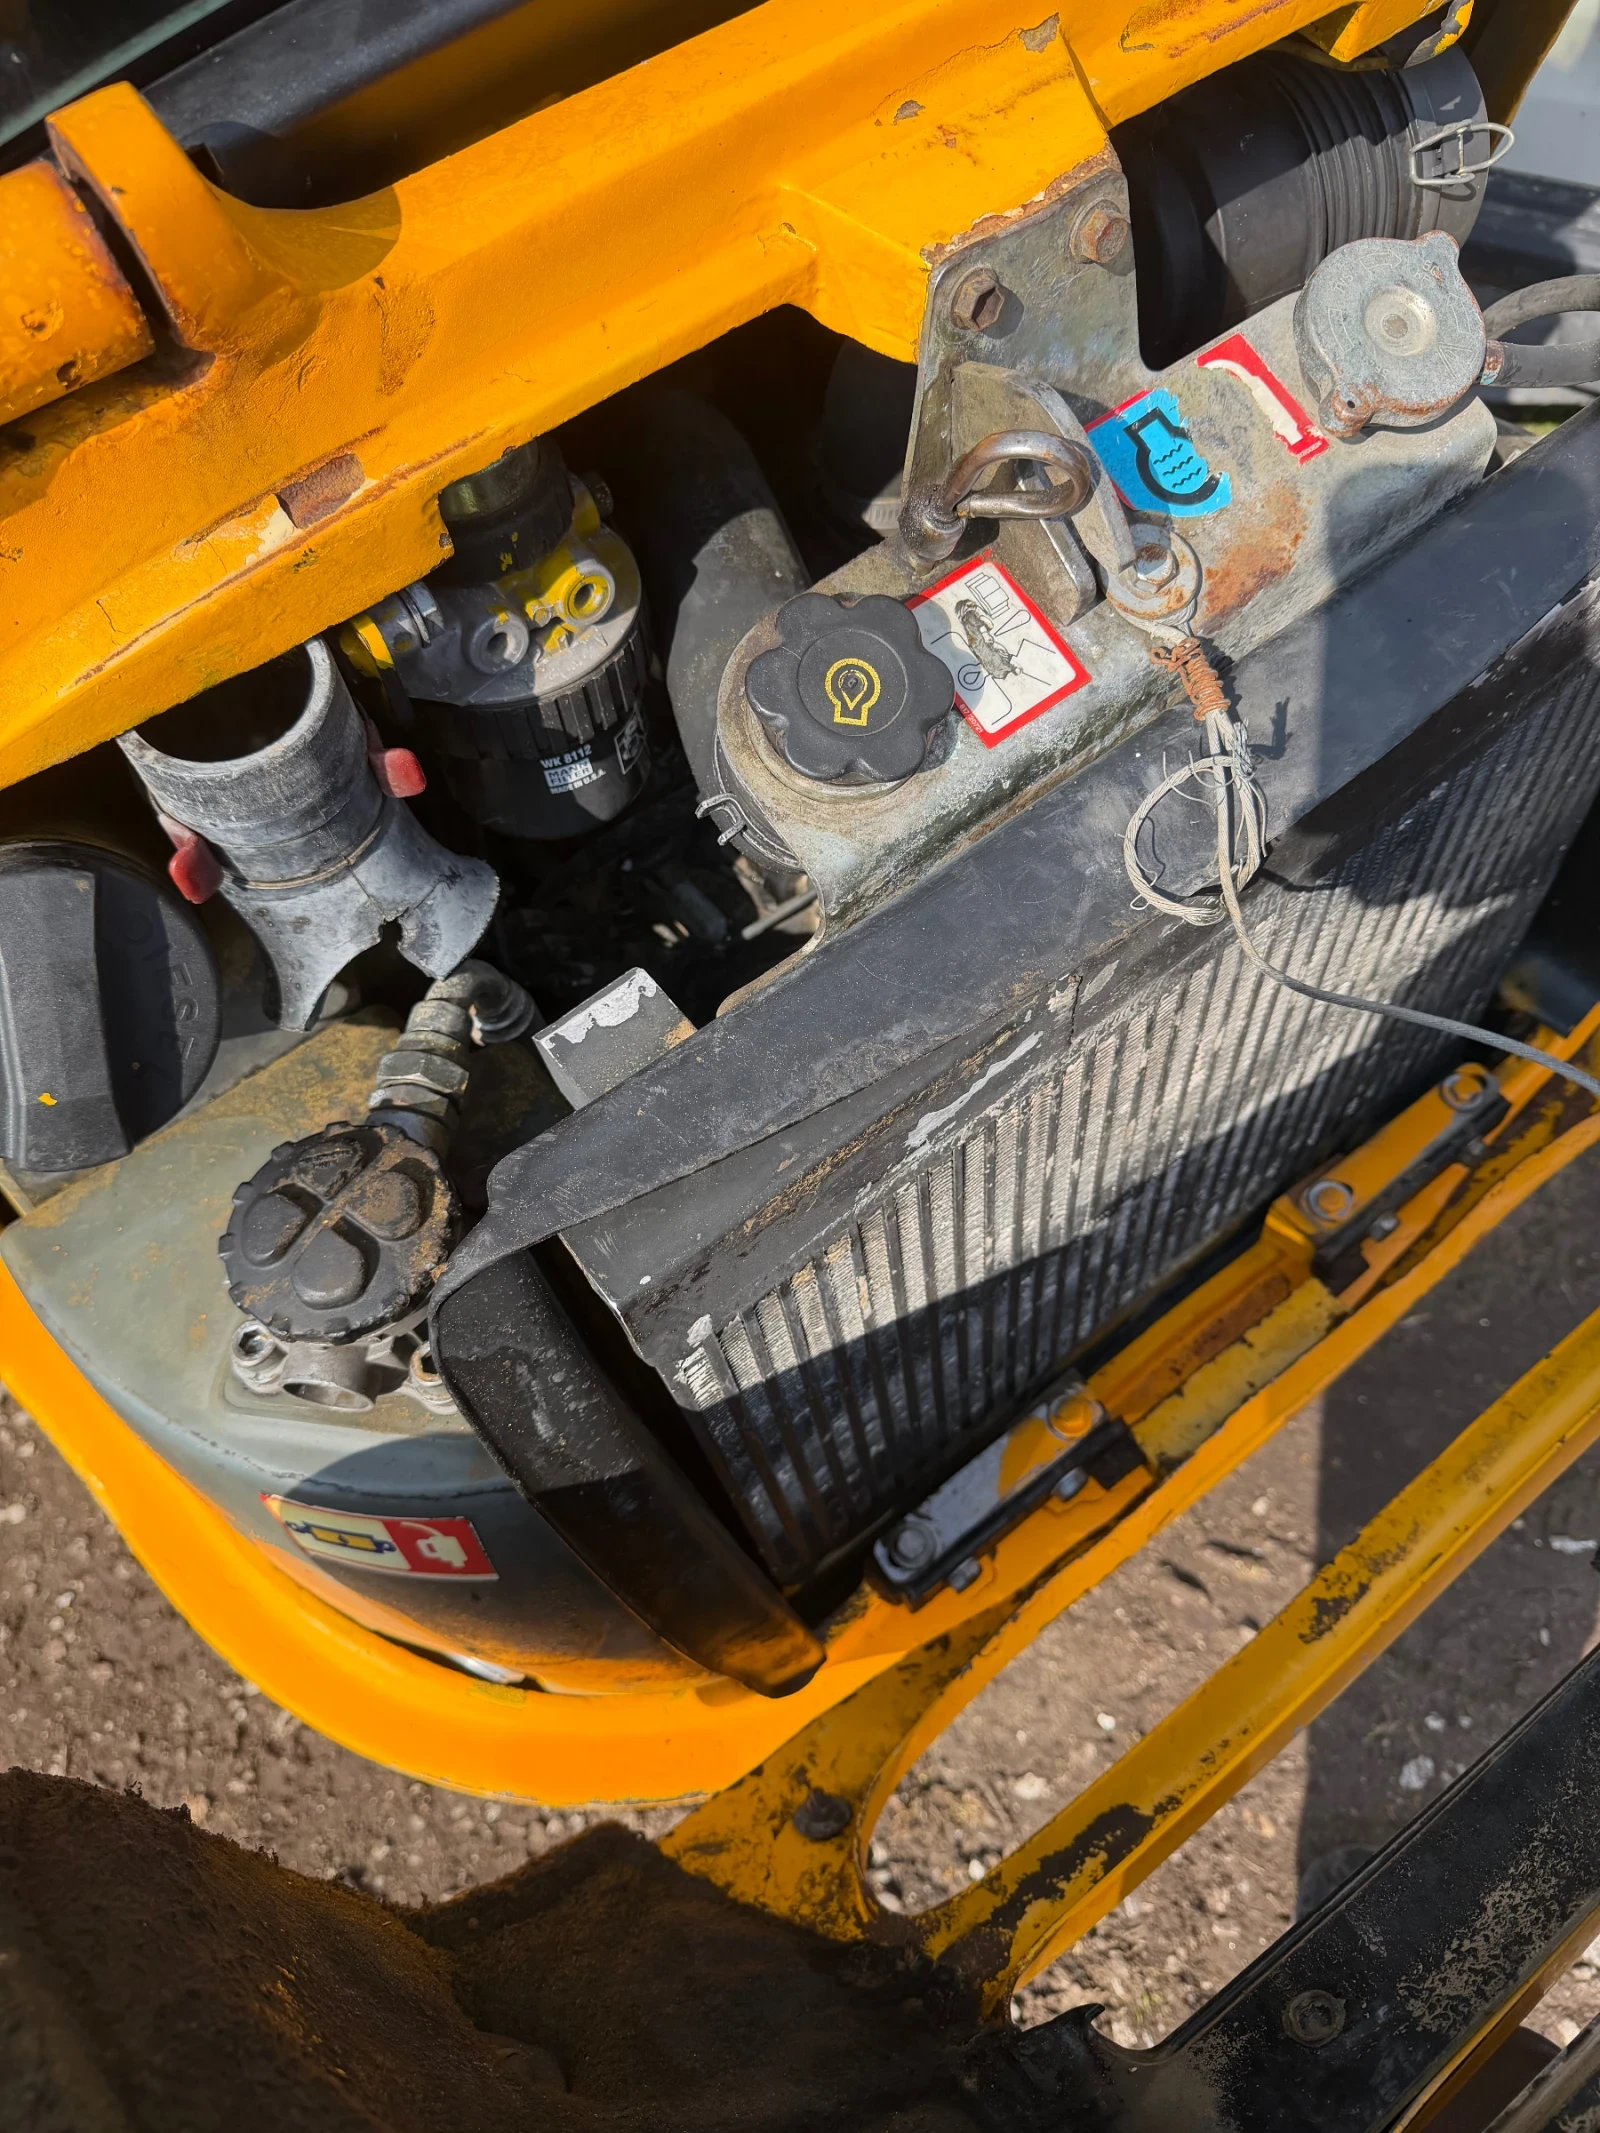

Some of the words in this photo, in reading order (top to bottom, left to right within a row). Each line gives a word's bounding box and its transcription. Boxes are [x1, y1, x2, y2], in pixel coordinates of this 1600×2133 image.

[540, 756, 562, 768] WK
[563, 744, 592, 763] 8112
[548, 760, 588, 778] MANN
[550, 767, 591, 784] FILTER
[550, 784, 573, 794] MADE
[573, 780, 583, 789] IN
